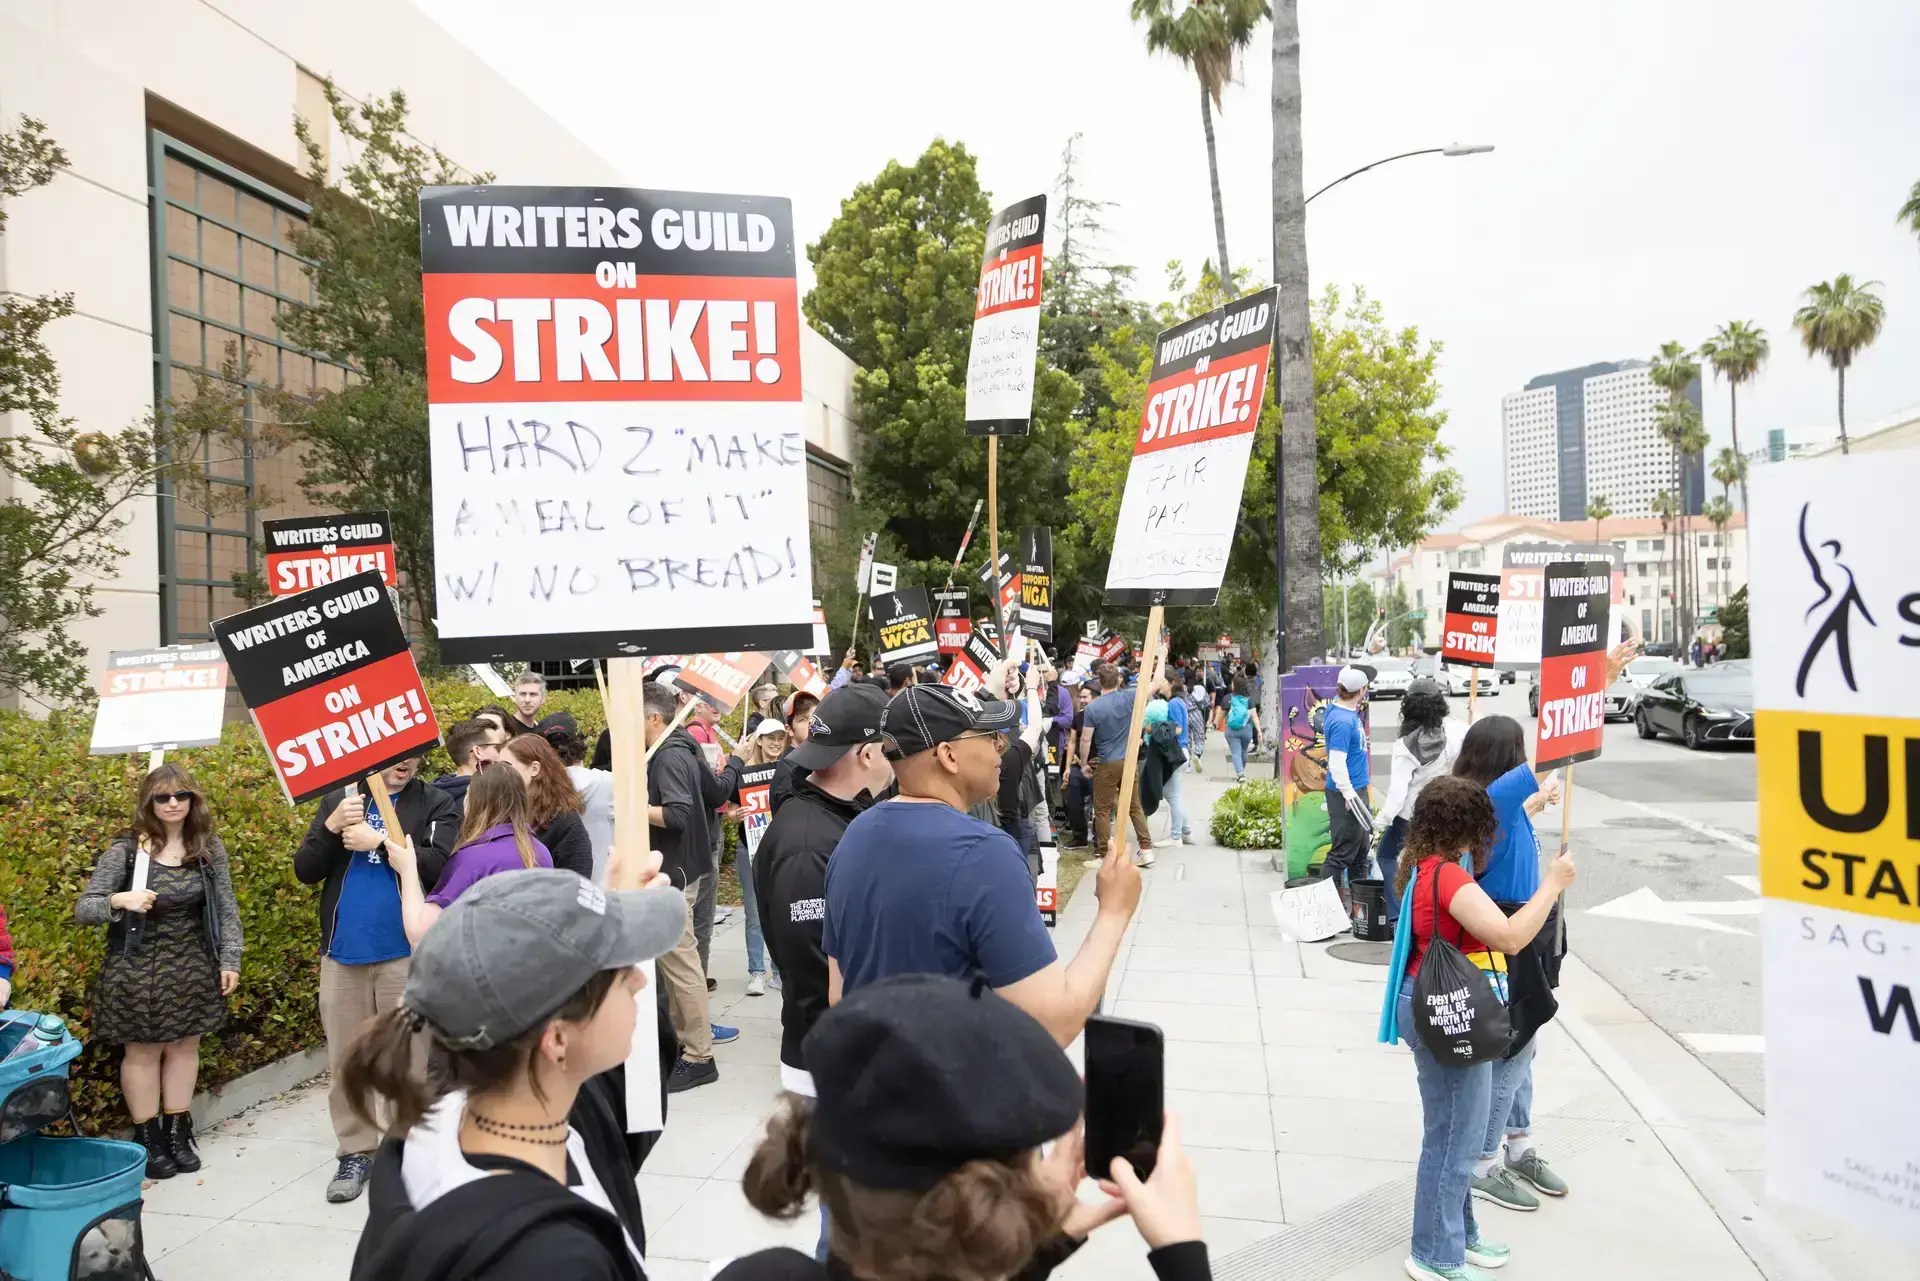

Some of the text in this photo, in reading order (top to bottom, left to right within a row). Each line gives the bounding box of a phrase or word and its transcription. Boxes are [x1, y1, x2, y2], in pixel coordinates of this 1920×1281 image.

[442, 205, 776, 252] WRITERS GUILD
[1011, 213, 1040, 241] GUILD
[1000, 247, 1008, 262] ON
[595, 261, 637, 289] ON
[980, 255, 1036, 311] STRIKE!
[447, 297, 782, 385] STRIKE!
[1160, 303, 1270, 366] WRITERS GUILD
[1195, 355, 1210, 375] ON
[1141, 364, 1258, 444] STRIKE!
[456, 415, 603, 475] HARD
[1145, 456, 1208, 495] FAIR
[627, 498, 683, 527] OF
[1144, 501, 1190, 533] PAY!
[273, 523, 383, 546] WRITERS GUILD
[322, 544, 337, 555] ON
[1511, 551, 1572, 564] WRITERS
[529, 564, 600, 603] NO
[618, 536, 798, 593] BREAD!
[1022, 573, 1050, 587] SUPPORTS
[1022, 585, 1050, 607] WGA
[1452, 579, 1490, 593] WRITERS
[1549, 575, 1609, 598] WRITERS GUILD
[1462, 602, 1499, 615] AMERICA
[1477, 594, 1487, 603] OF
[228, 585, 380, 652] WRITERS GUILD
[886, 613, 918, 625] SAG-AFTRA
[1577, 602, 1588, 619] OF
[880, 617, 929, 636] SUPPORTS
[1471, 621, 1488, 633] ON
[1560, 624, 1598, 646] AMERICA
[305, 628, 328, 650] OF
[881, 627, 931, 650] WGA
[282, 640, 371, 688] AMERICA
[110, 667, 219, 694] STRIKE!
[1571, 665, 1587, 689] ON
[324, 684, 362, 715] ON
[1540, 689, 1604, 740] STRIKE!
[276, 688, 428, 778] STRIKE!
[1427, 987, 1471, 1006] EVERY MILE
[1435, 1000, 1468, 1016] WILL BE
[1429, 1008, 1475, 1026] WORTH MY
